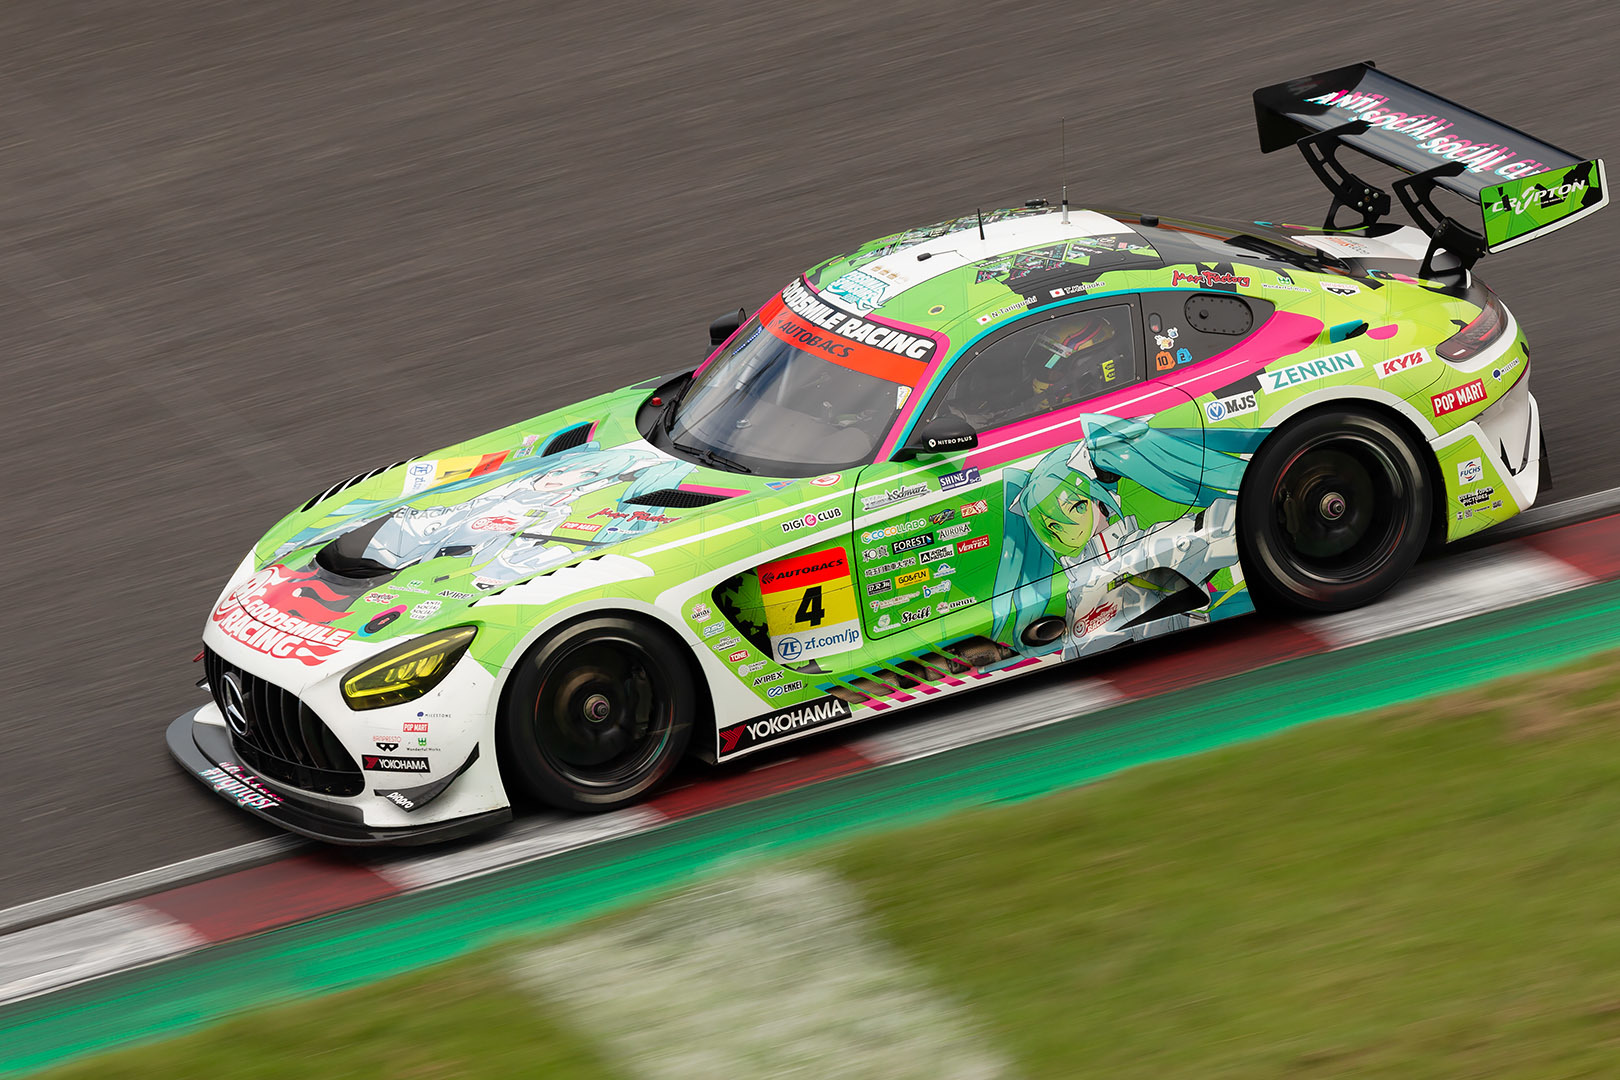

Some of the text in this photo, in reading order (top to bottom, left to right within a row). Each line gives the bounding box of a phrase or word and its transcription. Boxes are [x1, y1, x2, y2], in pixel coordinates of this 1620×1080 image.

[1304, 90, 1389, 114] ANTI
[1349, 108, 1453, 141] SOCIAL
[1417, 135, 1516, 173] SOCIAL
[1492, 179, 1586, 215] CRYPTON
[1172, 270, 1251, 287] Max Factory
[779, 321, 855, 358] AUTOBACS
[835, 317, 936, 360] RACING
[1157, 355, 1168, 367] 10
[1179, 352, 1186, 361] 2
[1383, 351, 1423, 375] KYB
[1268, 353, 1355, 390] ZENRIN
[1225, 394, 1256, 414] MJS
[1434, 382, 1484, 414] POP MART
[937, 435, 973, 446] NITRO PLUS
[1460, 465, 1481, 477] FUCHS
[564, 522, 579, 530] POP
[782, 508, 841, 532] DIGI CLUB
[871, 519, 924, 541] COCOLLABO
[939, 524, 970, 539] AURORA
[893, 536, 926, 551] FOREST
[775, 558, 843, 581] AUTOBACS
[898, 571, 926, 585] GO&FUN
[794, 585, 825, 628] 4
[902, 609, 931, 622] Steiff
[221, 608, 305, 658] RACING
[249, 599, 353, 646] GOODSMILE
[778, 629, 860, 661] ZF zf.com/jp
[730, 651, 747, 661] TONE
[753, 670, 784, 687] AVIREX
[403, 723, 427, 732] POP MART
[746, 699, 846, 741] YOKOHAMA
[378, 758, 428, 770] YOKOHAMA
